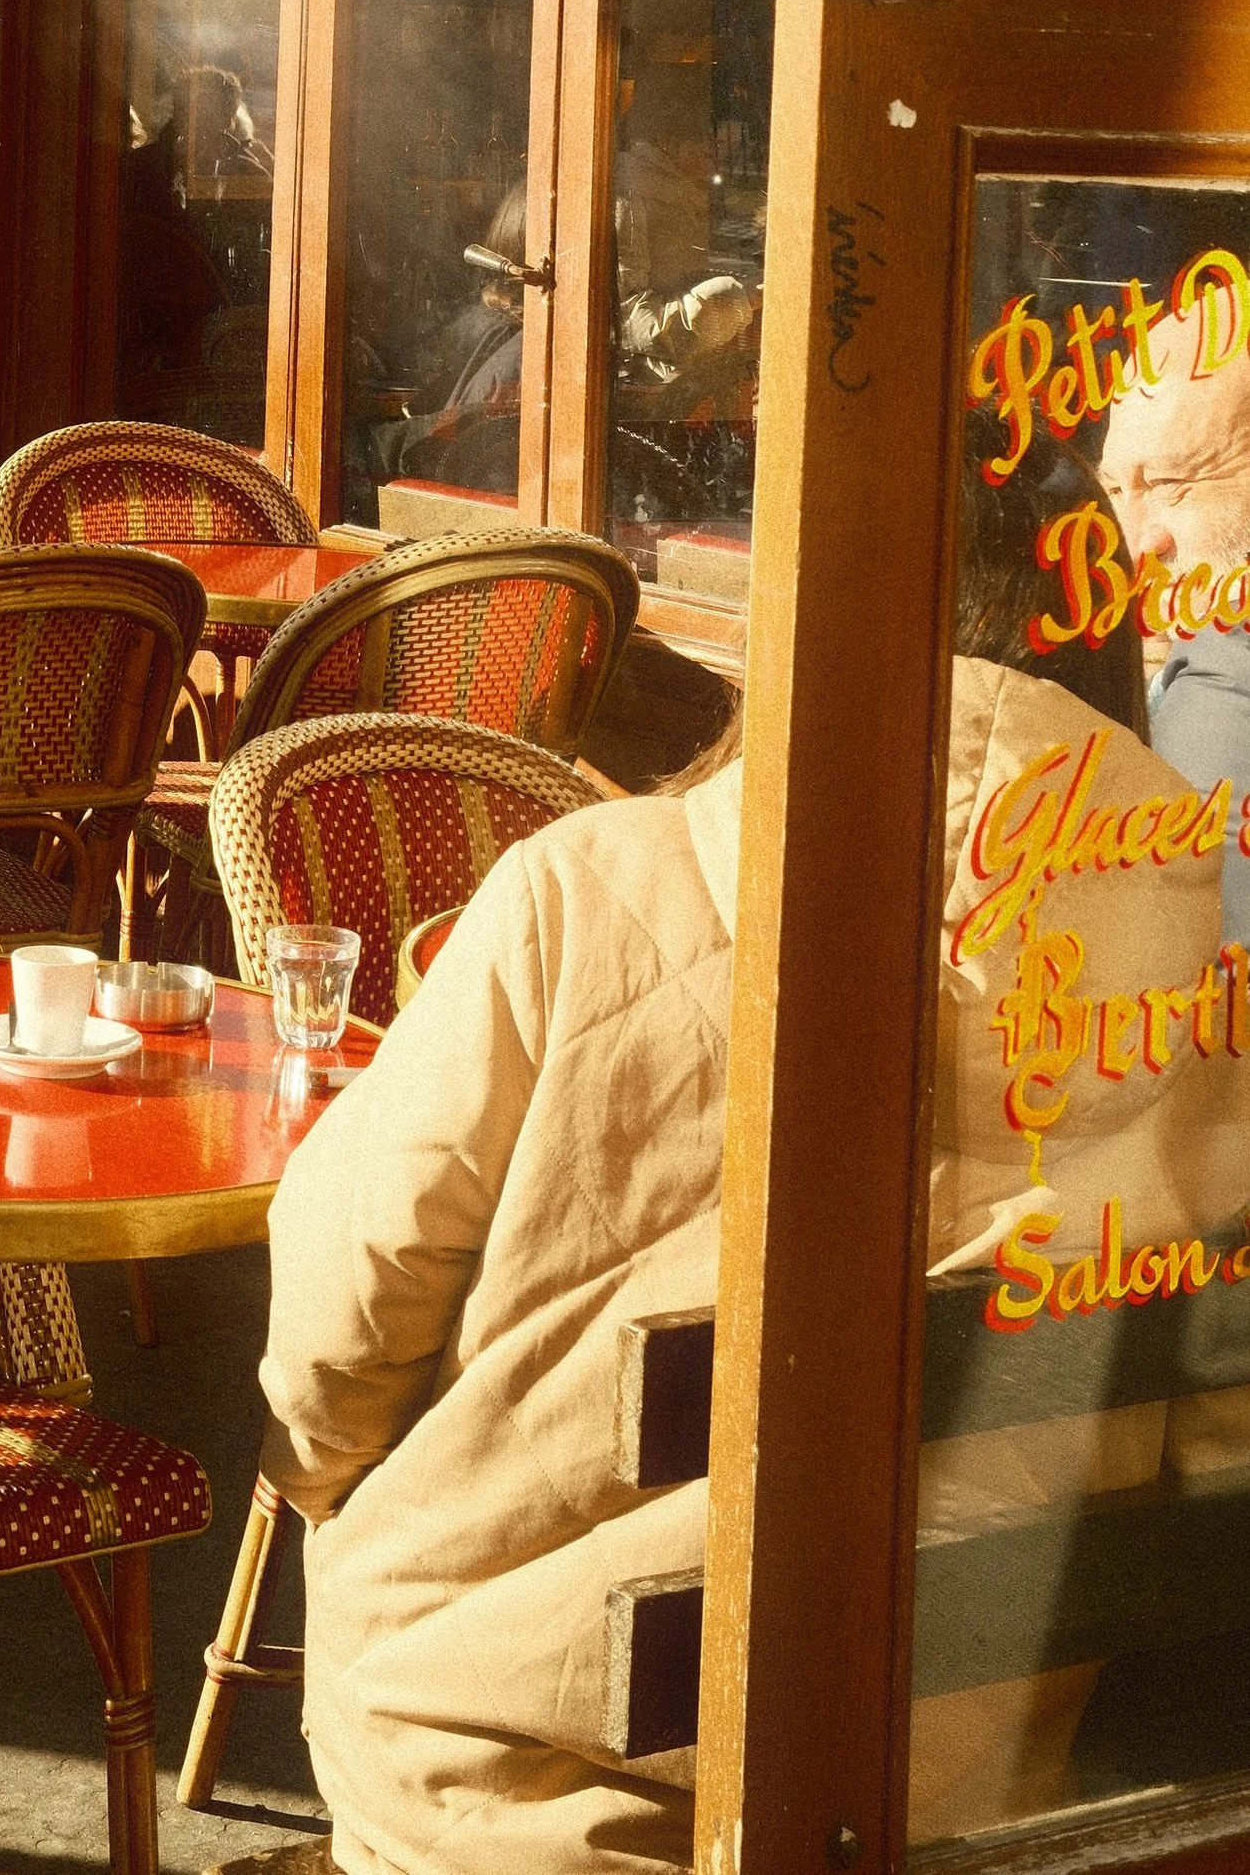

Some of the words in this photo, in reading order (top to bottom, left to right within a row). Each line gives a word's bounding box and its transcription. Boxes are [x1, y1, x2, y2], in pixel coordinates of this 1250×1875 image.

[964, 277, 1165, 487] Petit
[950, 728, 1232, 967] Glaces
[984, 1195, 1220, 1333] Salon
